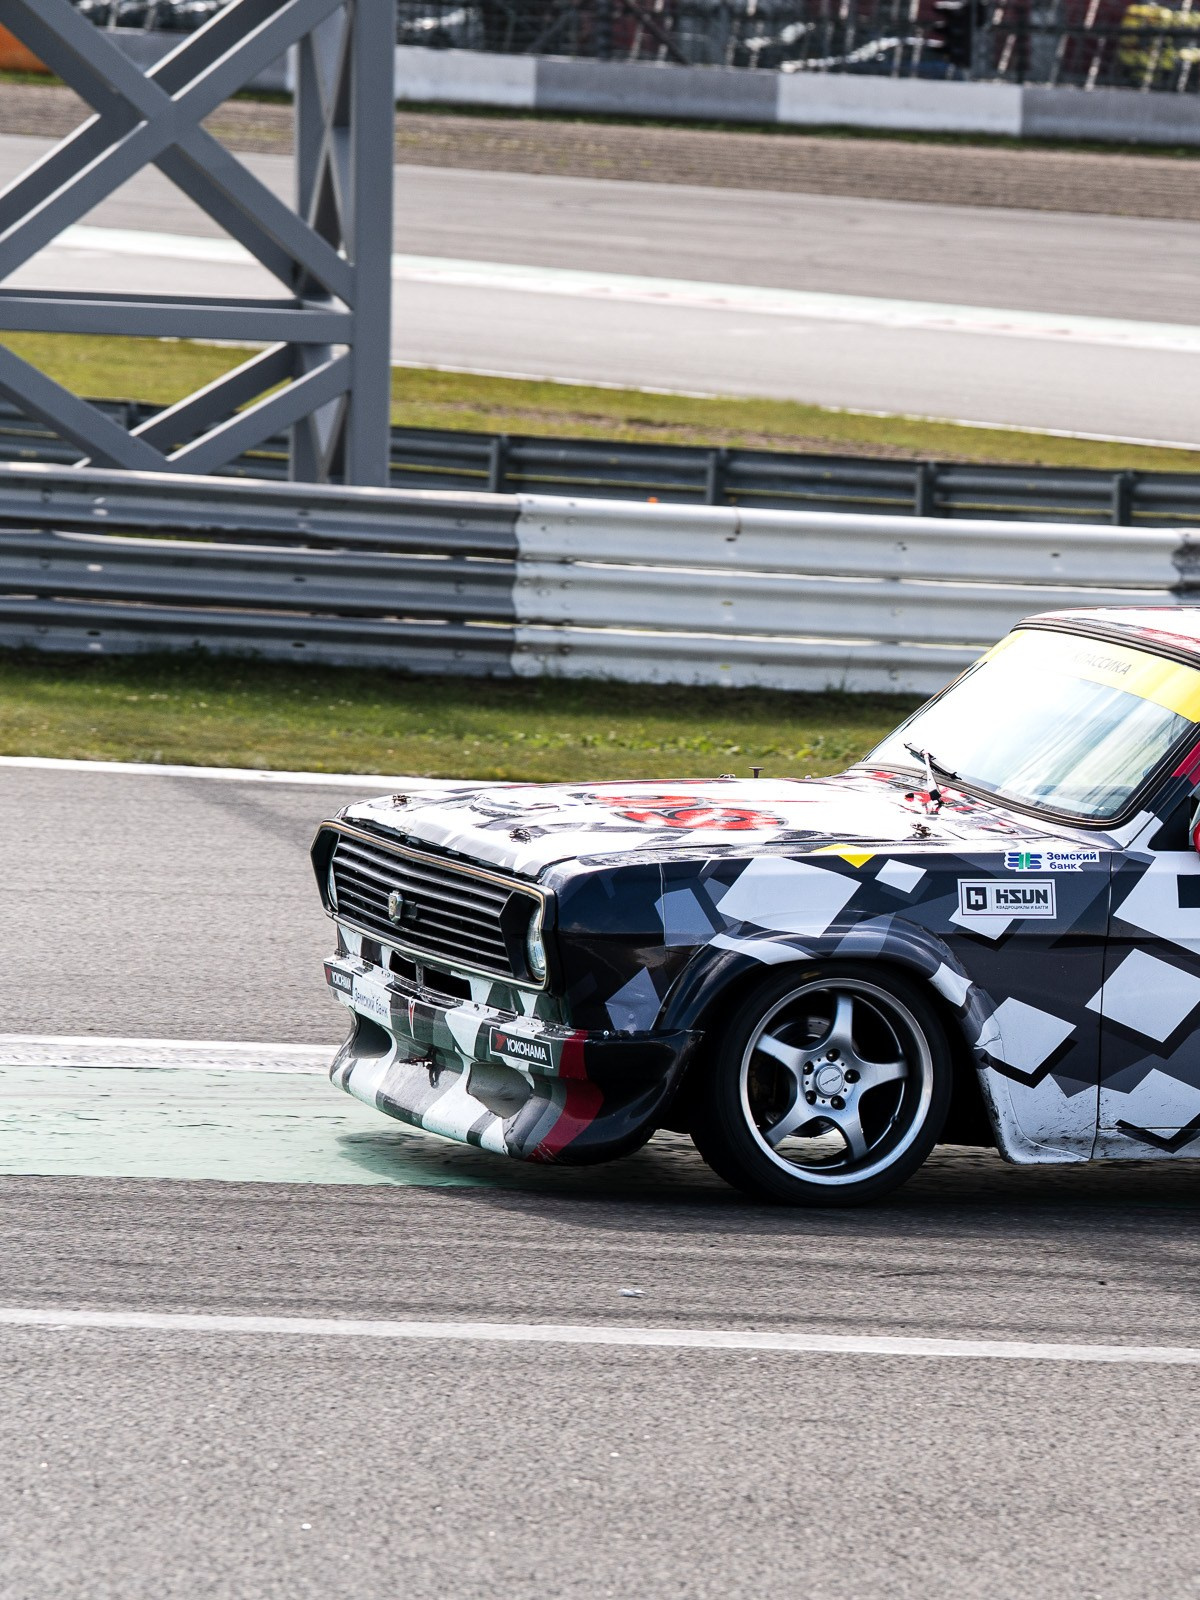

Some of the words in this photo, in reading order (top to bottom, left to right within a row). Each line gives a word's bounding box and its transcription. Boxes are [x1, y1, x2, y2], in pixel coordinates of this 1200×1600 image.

[1046, 851, 1097, 861] Земский
[1049, 861, 1077, 870] банк
[995, 889, 1049, 904] HSUN
[506, 1038, 548, 1061] YOKOHAMA
